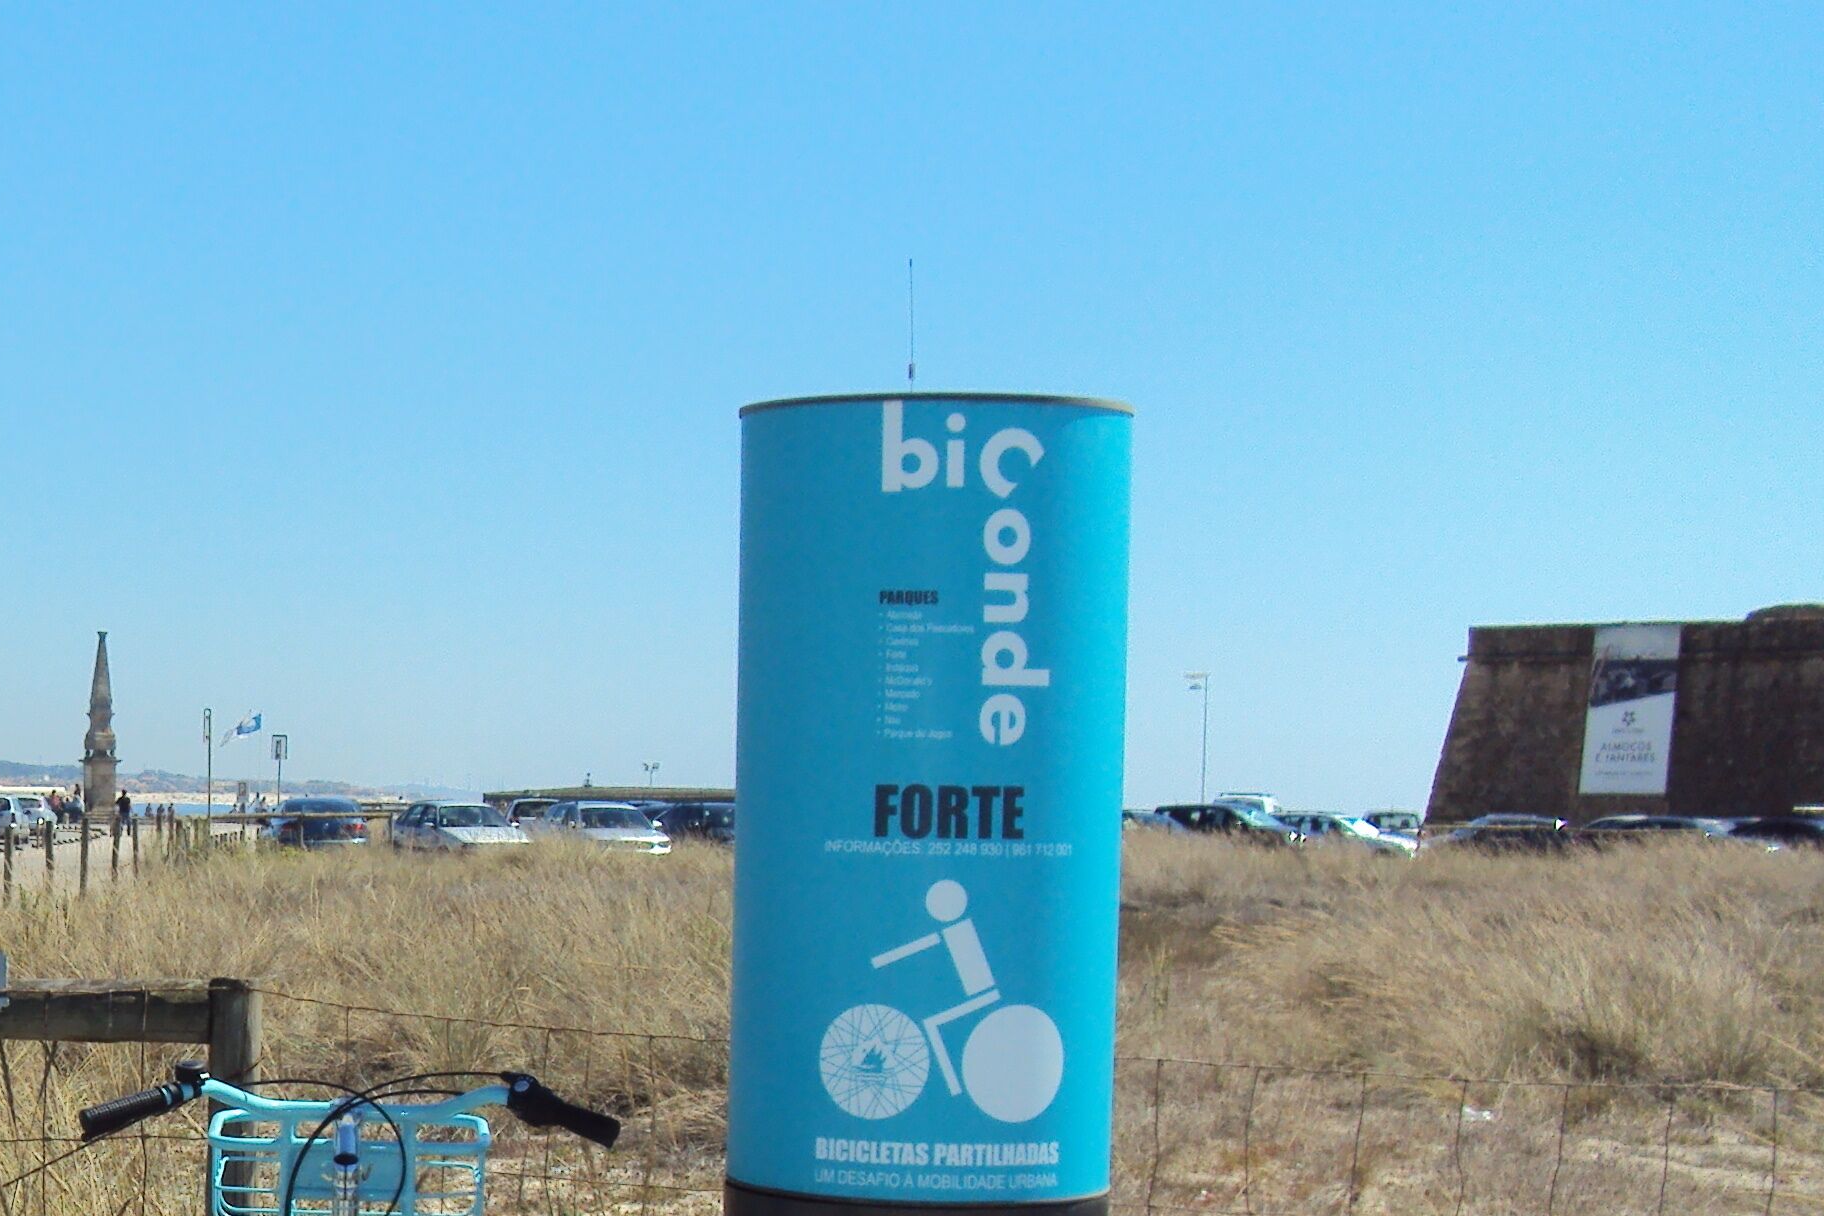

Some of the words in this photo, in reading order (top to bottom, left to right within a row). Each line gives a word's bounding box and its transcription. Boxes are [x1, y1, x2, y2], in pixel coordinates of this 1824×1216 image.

[879, 590, 939, 606] PARQUES
[873, 783, 1025, 839] FORTE
[815, 1137, 929, 1166] BICICLETAS
[933, 1141, 1060, 1168] PARTILHADAS
[838, 1170, 900, 1188] DESAFIO
[917, 1173, 1007, 1190] MOBILIDADE
